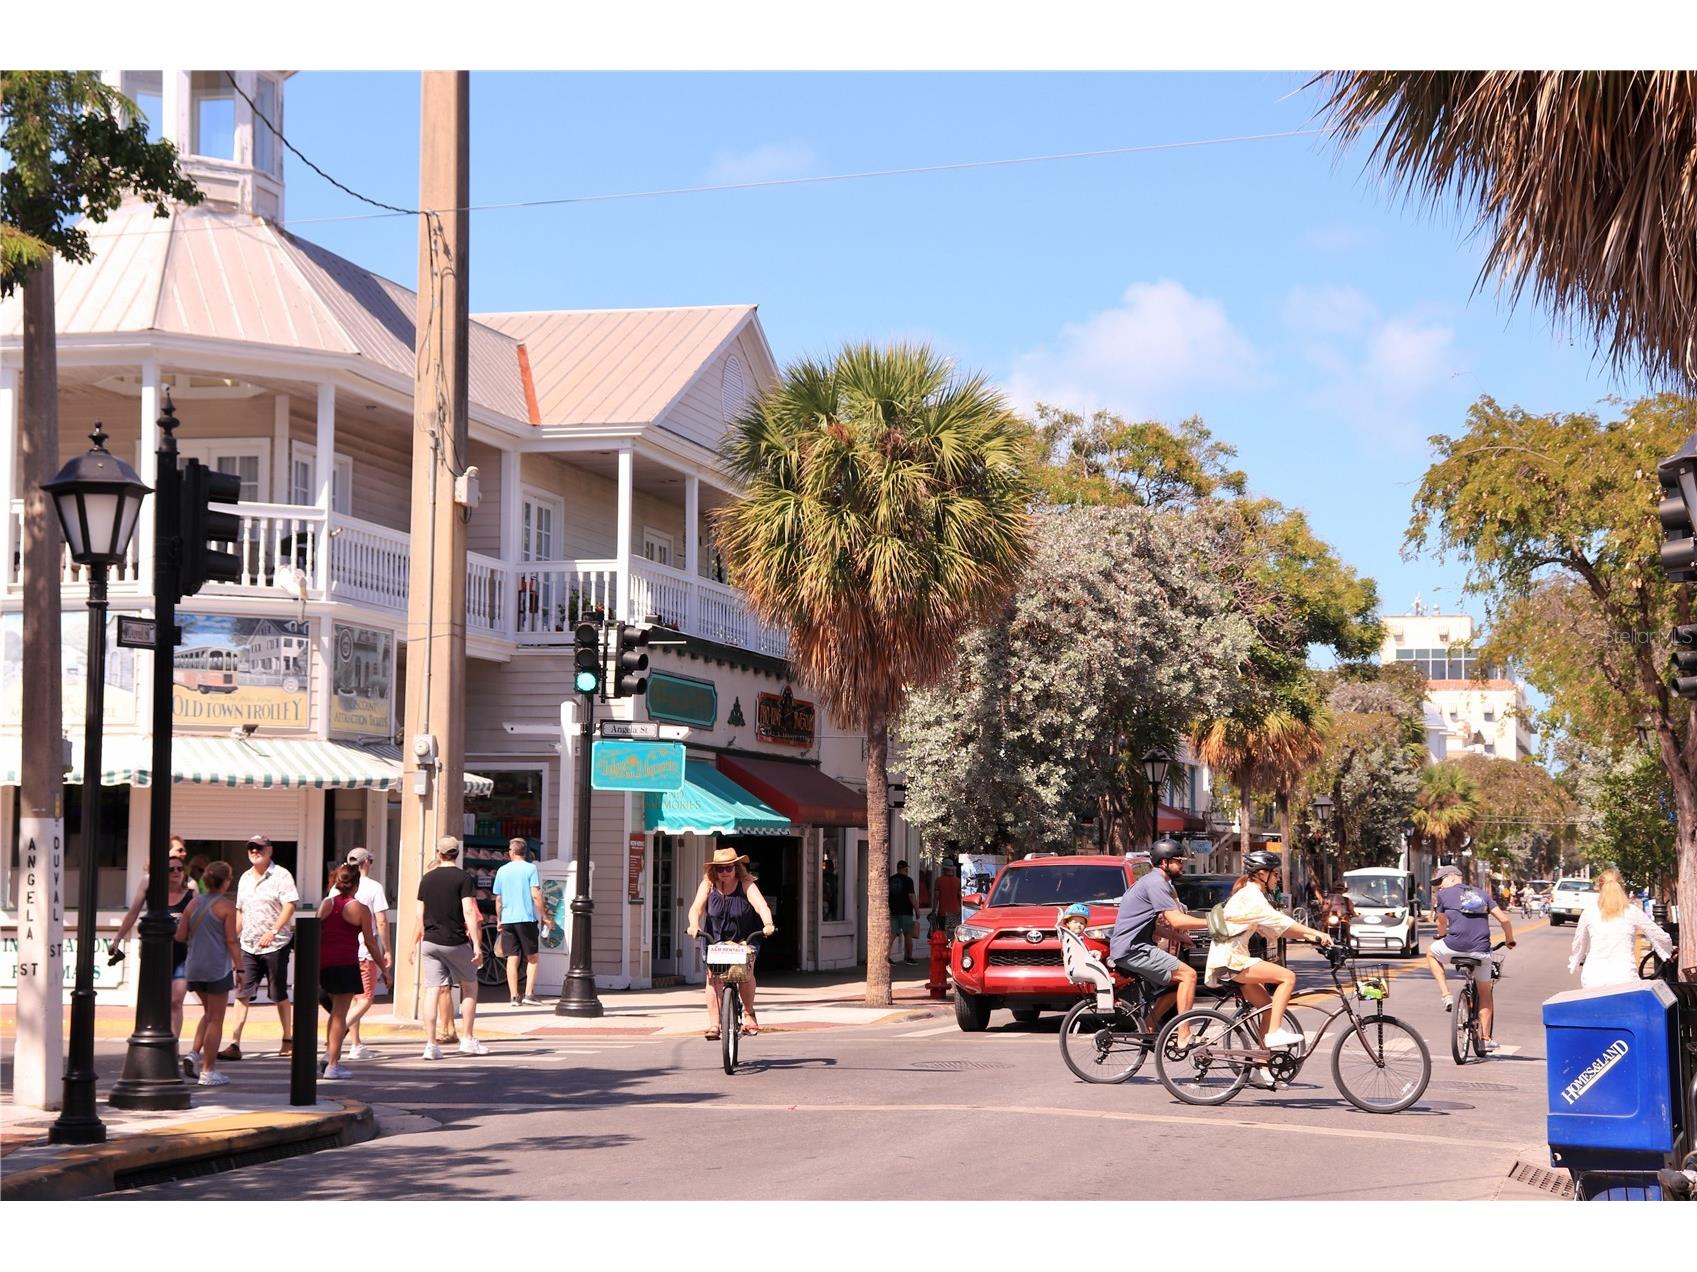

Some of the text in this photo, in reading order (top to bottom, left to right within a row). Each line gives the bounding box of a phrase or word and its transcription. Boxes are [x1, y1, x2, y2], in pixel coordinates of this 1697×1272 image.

[173, 694, 302, 721] OLD TOWN TROLLEY
[610, 724, 648, 734] Angela St
[26, 837, 37, 940] ANGELA
[52, 836, 60, 922] DUVAL
[50, 943, 62, 958] ST
[20, 962, 39, 976] ST
[1560, 1039, 1629, 1105] HOMES&LAND
